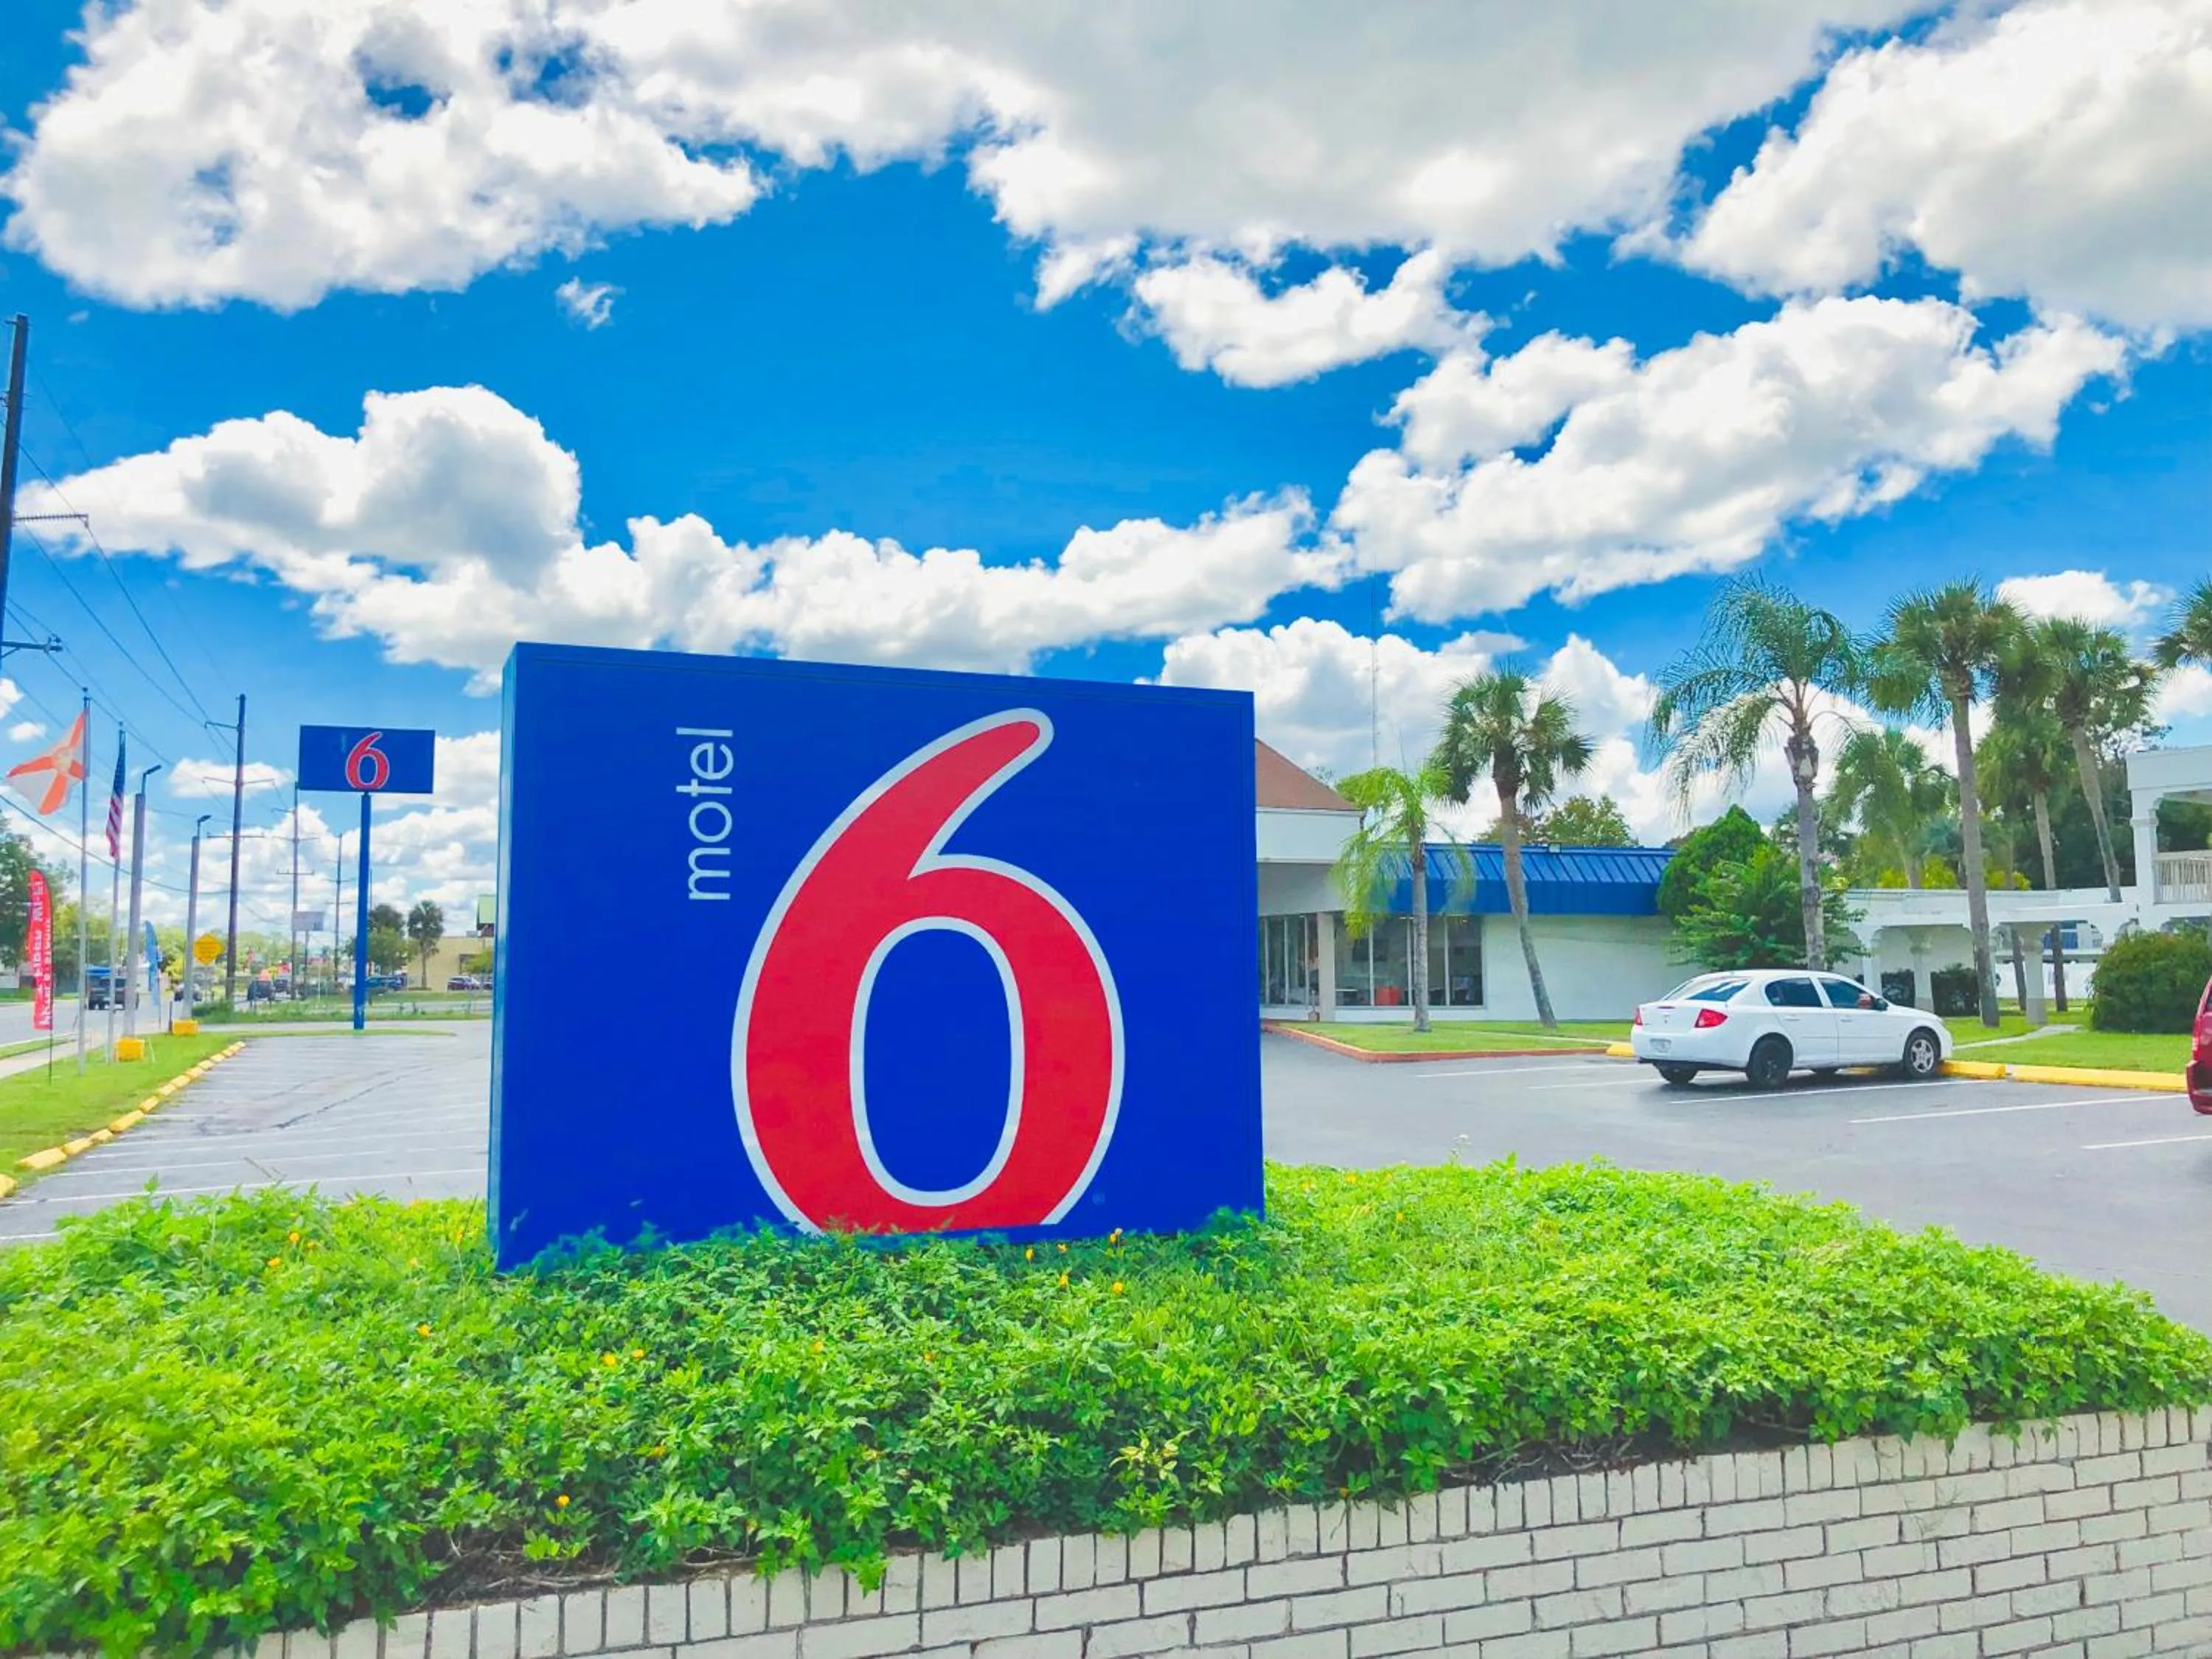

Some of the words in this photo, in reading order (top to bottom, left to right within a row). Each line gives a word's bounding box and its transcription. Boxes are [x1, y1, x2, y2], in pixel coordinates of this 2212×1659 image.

[345, 731, 390, 790] 6
[675, 727, 734, 900] motel
[730, 706, 1125, 1237] 6
